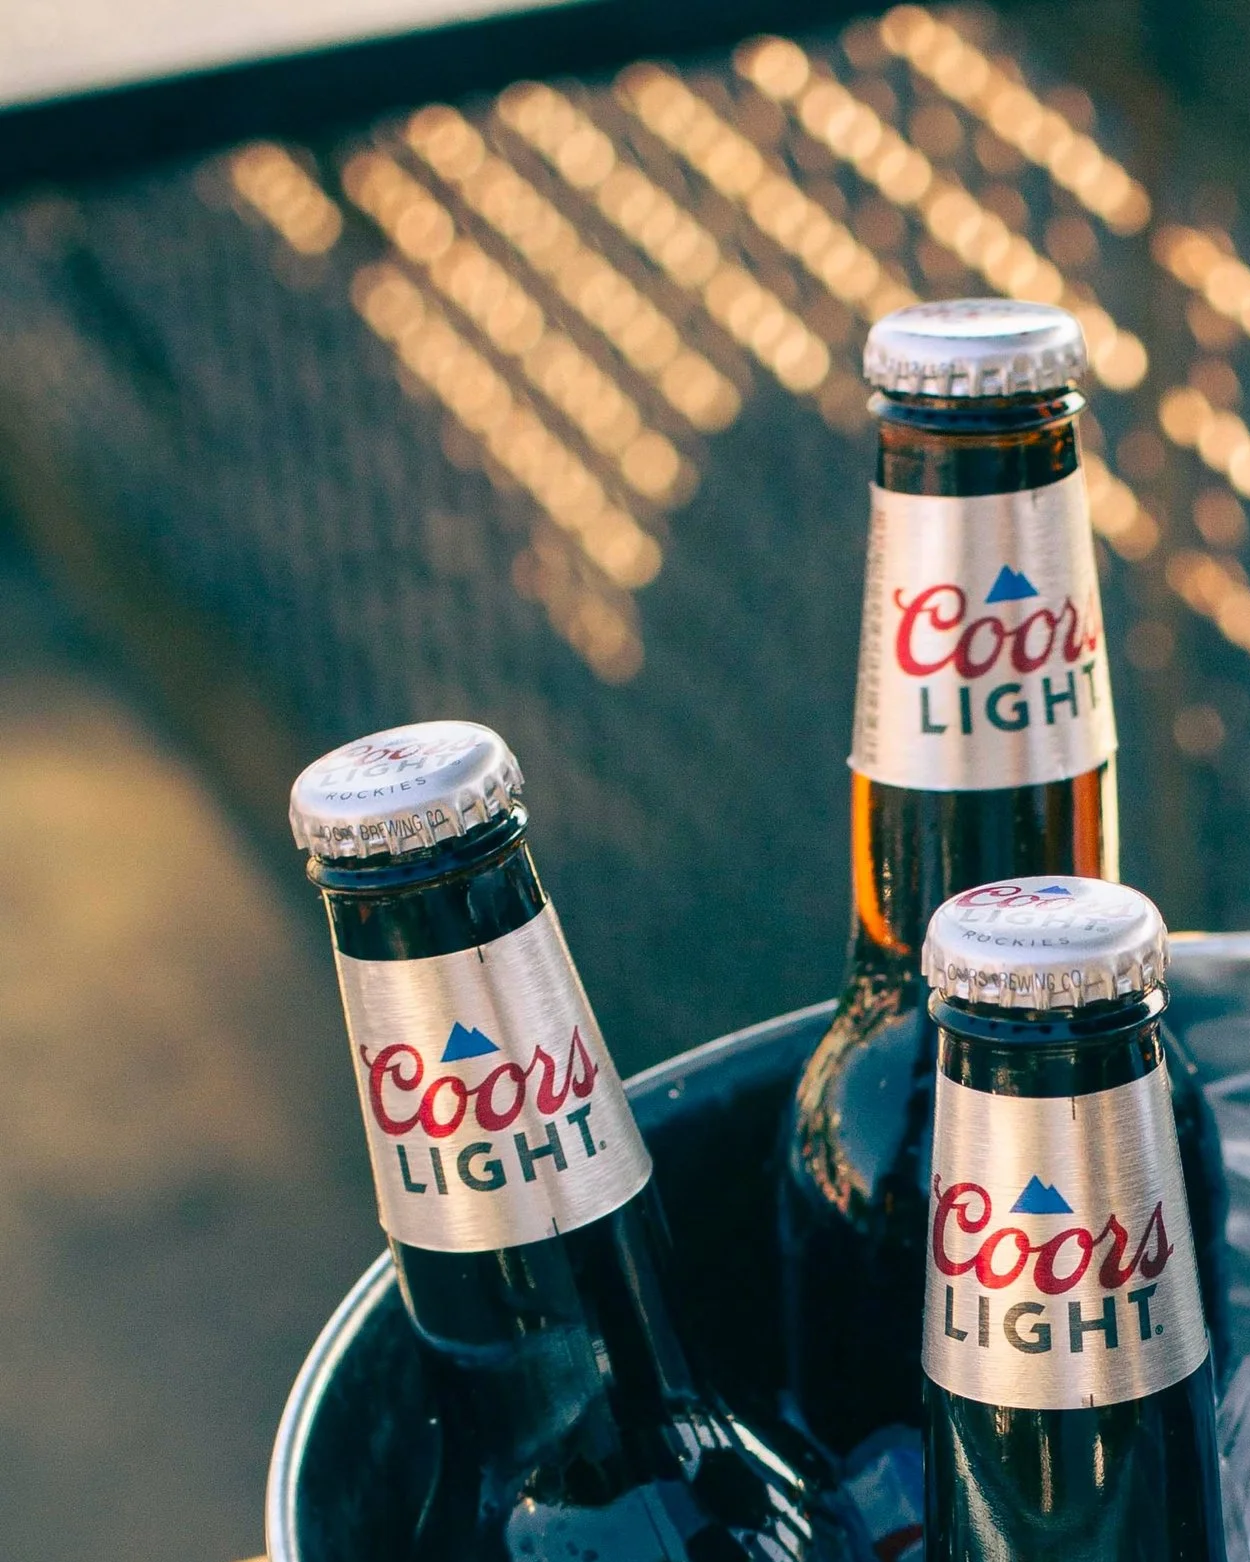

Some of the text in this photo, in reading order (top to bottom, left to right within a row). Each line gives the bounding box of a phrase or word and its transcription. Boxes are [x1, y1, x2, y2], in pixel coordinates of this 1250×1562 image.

[893, 584, 1101, 679] Coors
[919, 660, 1096, 735] LIGHT
[359, 1024, 599, 1139] Coors
[396, 1102, 598, 1196] LIGHT
[932, 1173, 1175, 1296] Coors
[944, 1282, 1158, 1354] LIGHT
